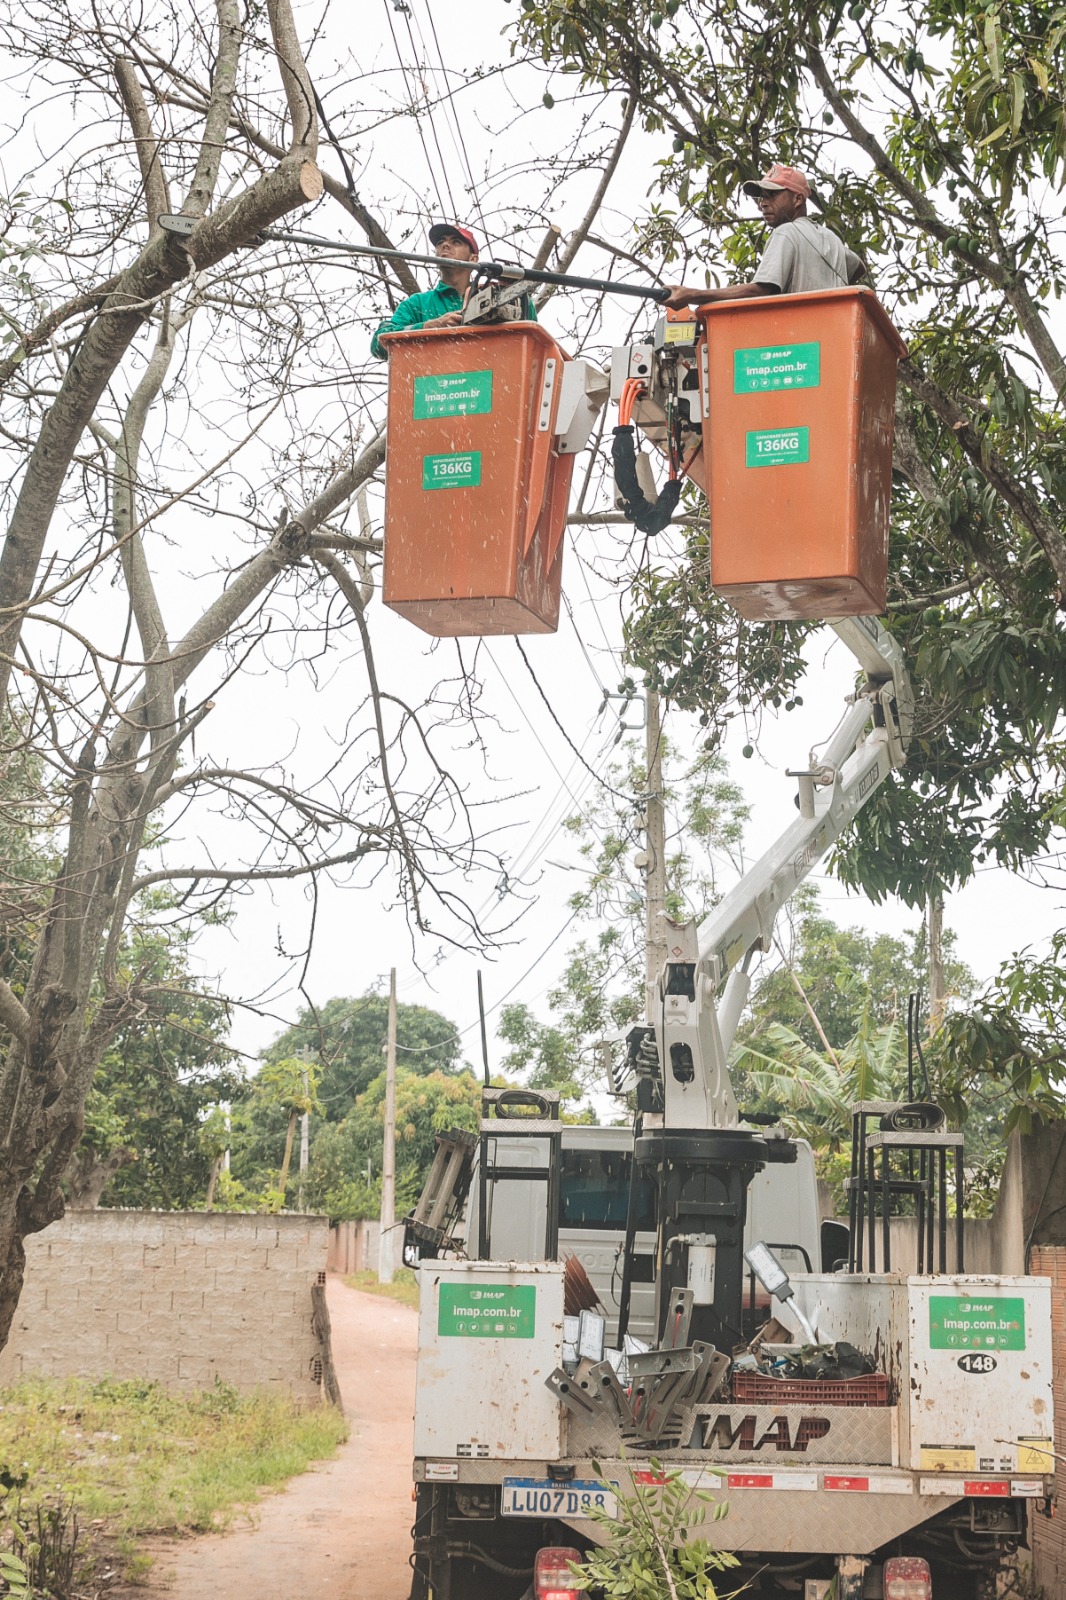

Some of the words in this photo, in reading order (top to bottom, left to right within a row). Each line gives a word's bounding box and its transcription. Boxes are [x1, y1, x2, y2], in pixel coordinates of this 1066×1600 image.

[772, 350, 792, 358] IMAP
[746, 361, 808, 376] imap.com.br
[424, 388, 481, 402] imap.com.br
[756, 437, 799, 452] 136KG
[432, 461, 472, 475] 136KG
[482, 1291, 505, 1299] IMAP
[453, 1305, 522, 1319] imap.com.br
[972, 1304, 994, 1312] IMAP
[943, 1318, 1012, 1332] imap.com.br
[962, 1356, 994, 1371] 148
[685, 1413, 831, 1452] IMAP
